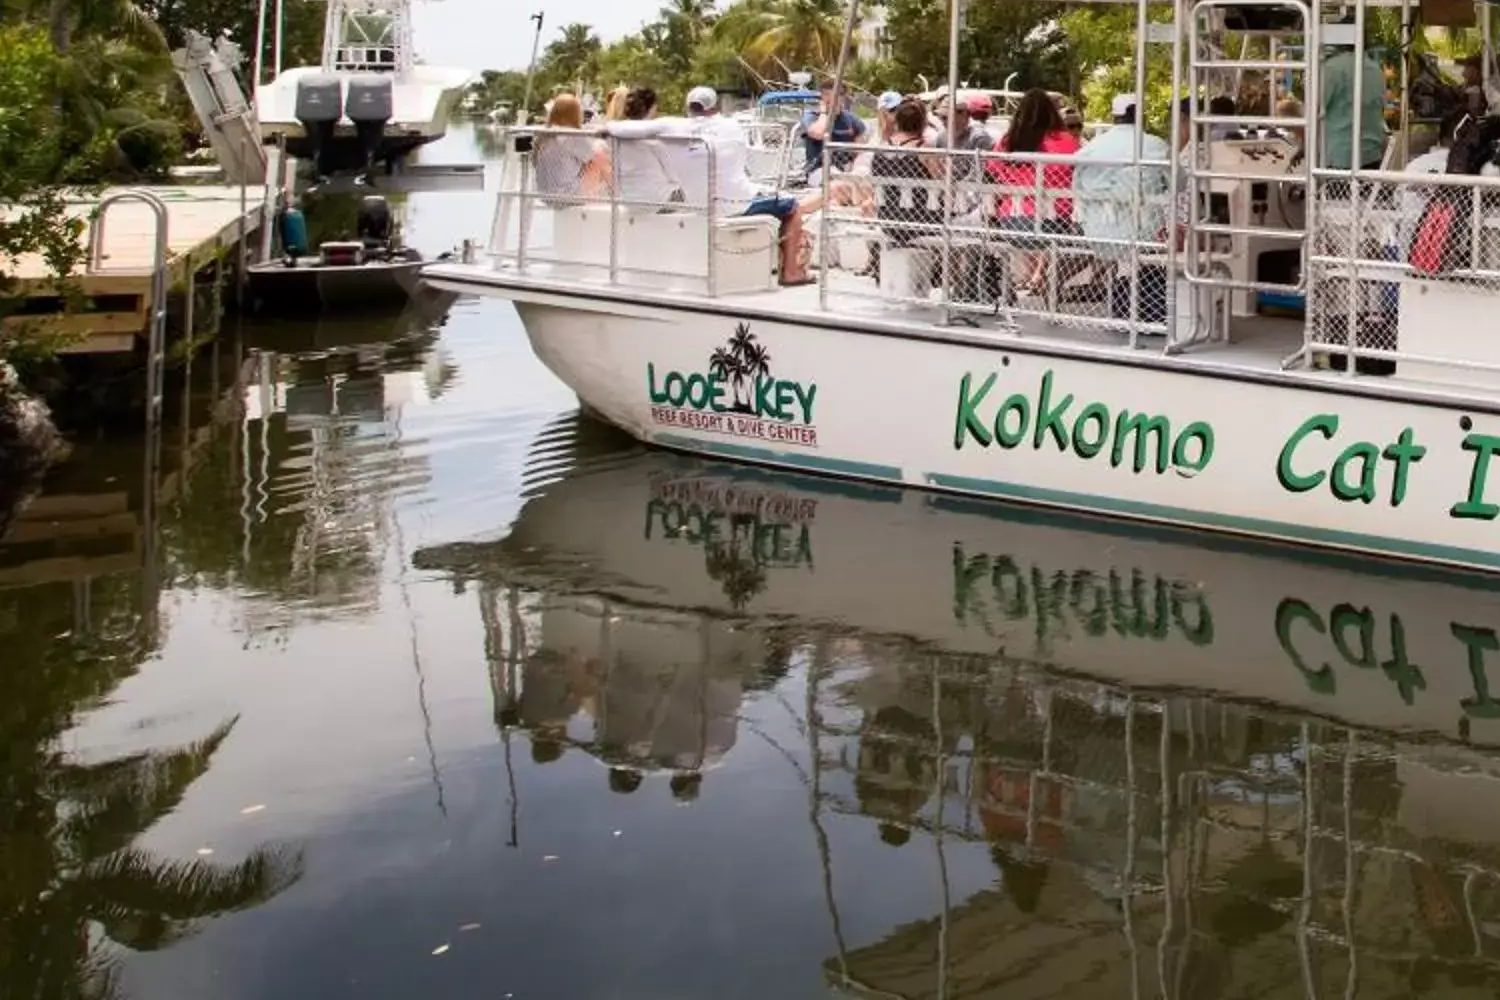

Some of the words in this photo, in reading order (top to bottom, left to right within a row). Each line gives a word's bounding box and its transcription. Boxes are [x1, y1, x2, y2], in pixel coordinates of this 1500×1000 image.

[647, 362, 727, 412] LOOE
[756, 374, 816, 424] KEY
[651, 407, 677, 423] REEF
[679, 411, 722, 430] RESORT
[727, 417, 735, 431] &
[738, 419, 765, 437] DIVE
[768, 424, 817, 444] CENTER
[954, 370, 1215, 478] Kokomo
[1276, 413, 1424, 507] Cat
